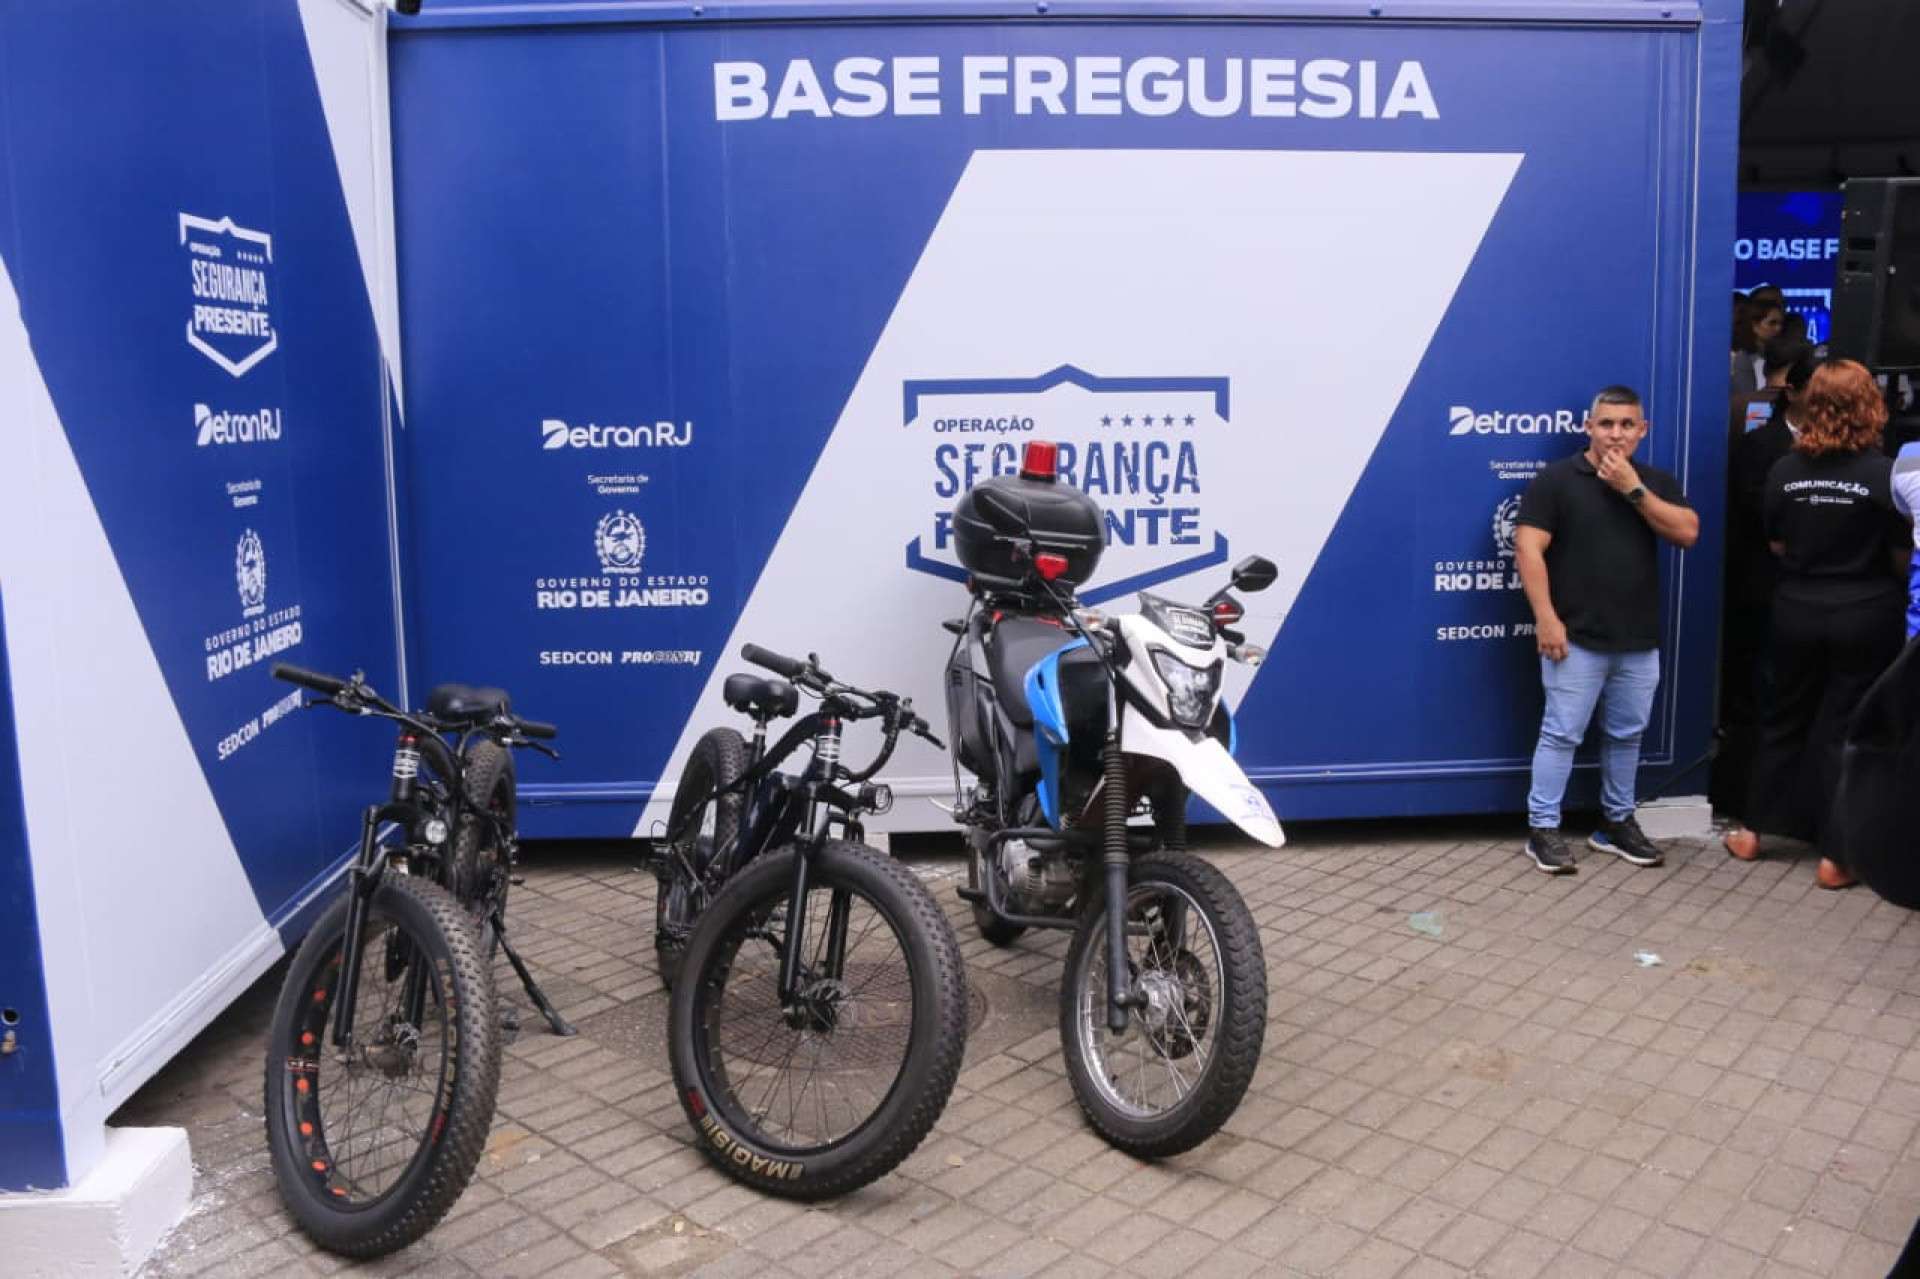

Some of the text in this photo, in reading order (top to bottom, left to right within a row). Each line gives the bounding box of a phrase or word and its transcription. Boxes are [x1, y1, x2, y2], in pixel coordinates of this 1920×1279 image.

[713, 56, 1441, 120] BASE FREGUESIA
[1757, 238, 1821, 260] BASE
[192, 259, 268, 310] SEGURANÇA
[194, 305, 270, 337] PRESENTE
[542, 419, 692, 449] DetranRJ
[933, 415, 1035, 435] OPERAÇÃO
[1490, 460, 1548, 470] Secretaria de
[588, 475, 649, 484] Secretaria de
[1784, 479, 1870, 496] COMUNICAÇÃO
[598, 485, 640, 495] Governo
[1434, 561, 1506, 572] GOVERNO
[536, 575, 710, 589] GOVERNO DO ESTADO
[1434, 572, 1474, 592] RIO
[1475, 572, 1504, 590] DE
[537, 588, 710, 609] RIO DE JANEIRO
[204, 623, 251, 651] GOVERNO
[253, 617, 266, 634] DO
[268, 605, 302, 628] ESTADO
[1437, 625, 1506, 641] SEDCON
[206, 621, 303, 682] RIO DE JANEIRO
[539, 650, 613, 665] SEDCON
[217, 717, 261, 760] SEDCON
